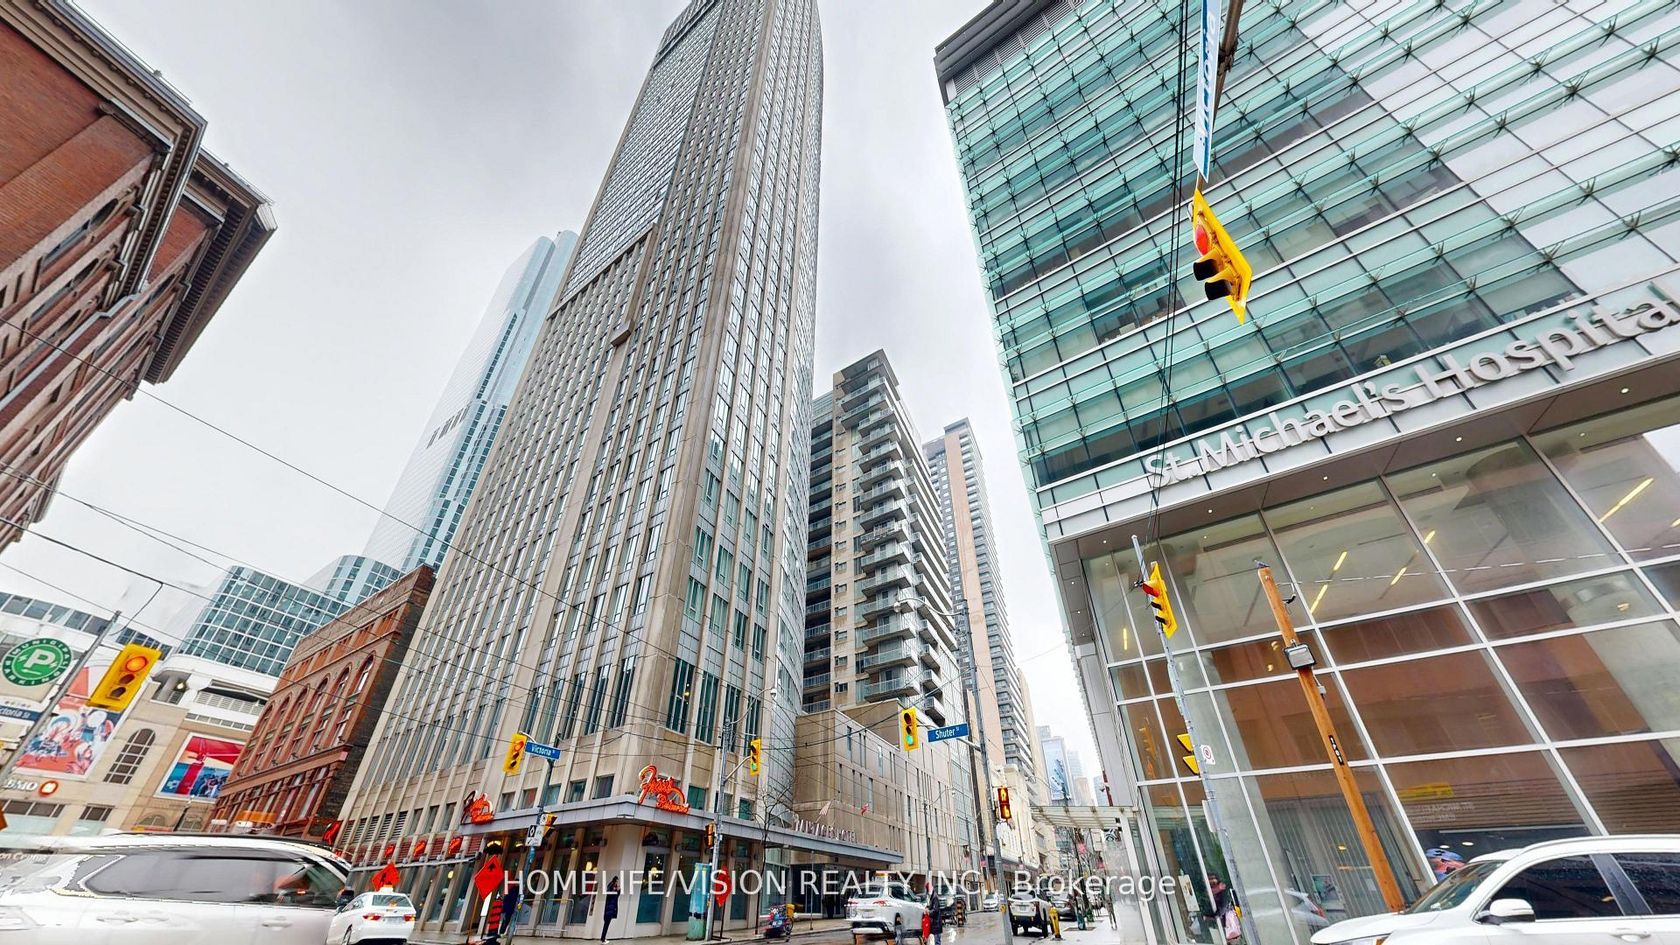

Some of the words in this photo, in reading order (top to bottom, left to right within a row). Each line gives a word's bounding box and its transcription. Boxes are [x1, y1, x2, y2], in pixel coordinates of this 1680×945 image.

[1144, 450, 1196, 488] St.
[1197, 379, 1410, 473] Michael's
[1413, 280, 1680, 400] Hospital
[12, 639, 71, 667] MUNICIPAL
[23, 648, 56, 669] P
[4, 659, 61, 685] PARKING
[935, 728, 955, 740] Shuter
[531, 743, 551, 756] Victoria
[6, 779, 38, 791] BMO
